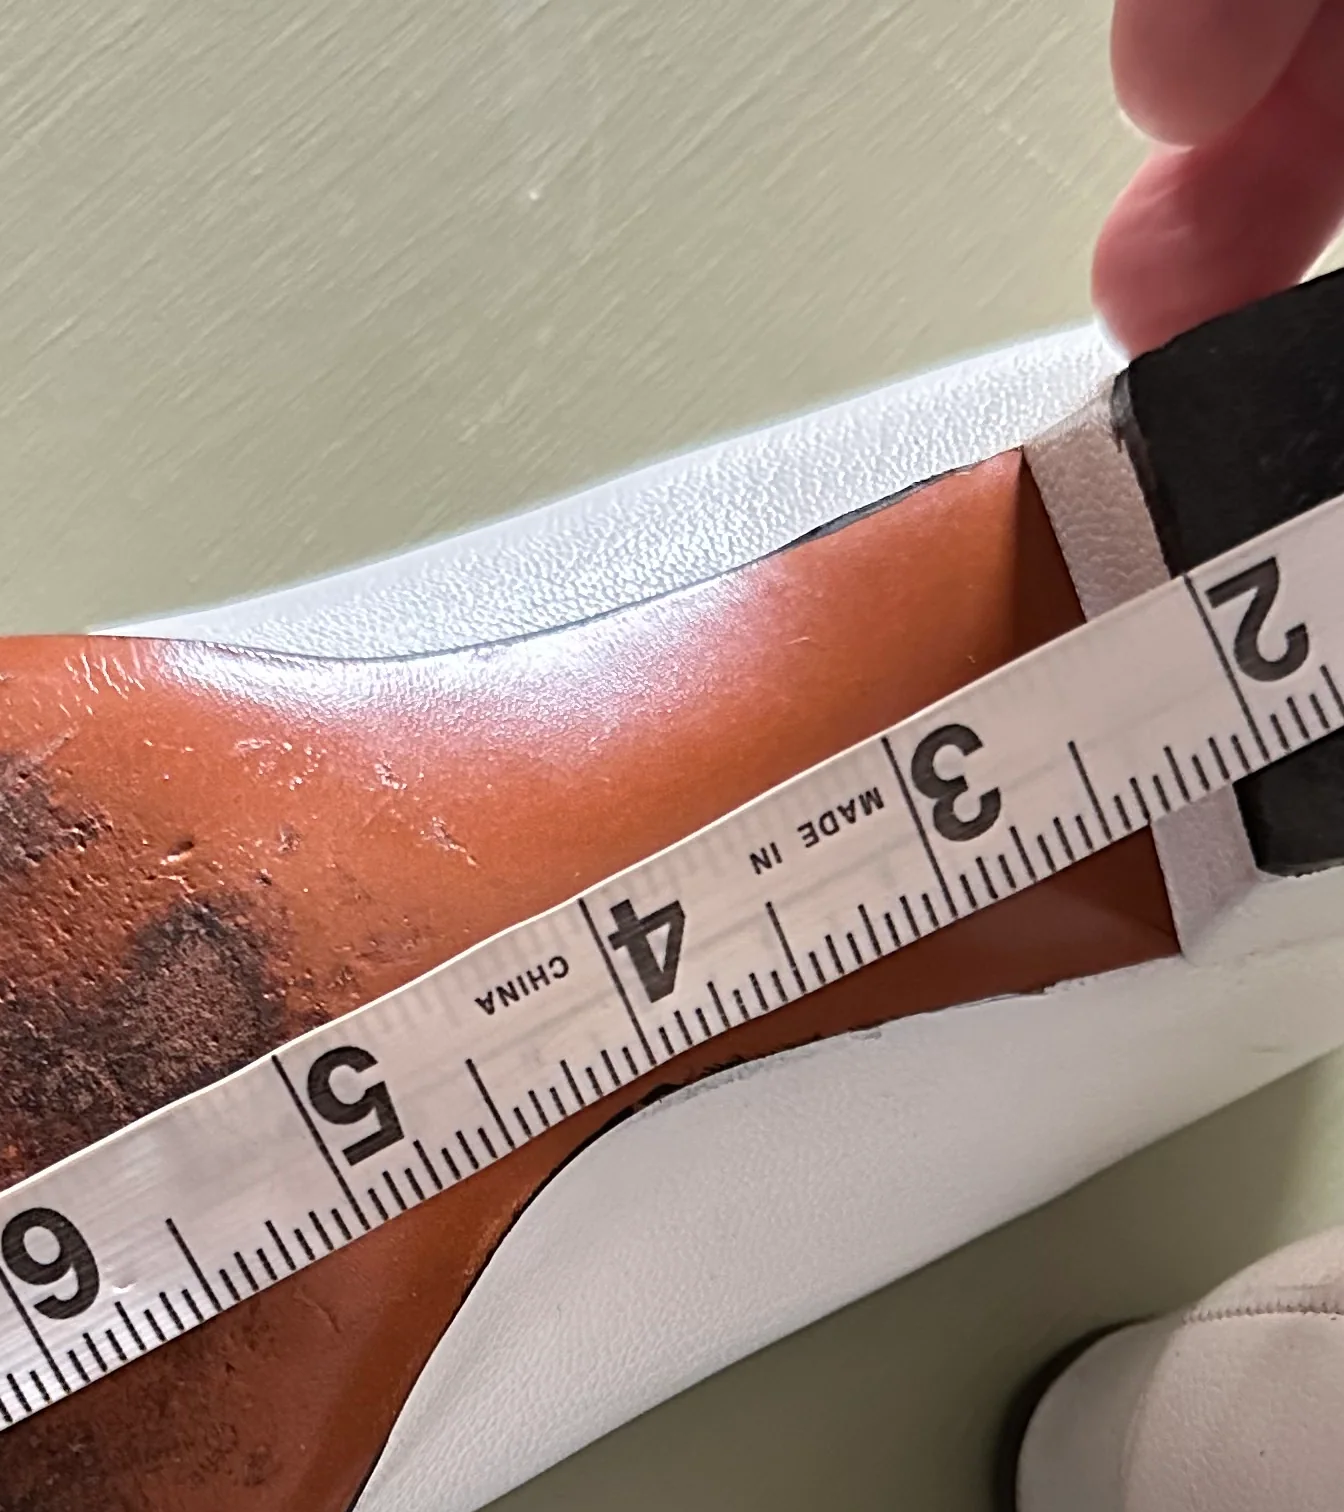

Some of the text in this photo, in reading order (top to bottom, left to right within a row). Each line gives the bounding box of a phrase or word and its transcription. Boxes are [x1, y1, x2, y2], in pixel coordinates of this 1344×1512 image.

[1206, 556, 1311, 683] 2
[910, 723, 1002, 842] 3
[474, 786, 886, 1016] MADE IN CHINA
[607, 898, 686, 1004] 4
[307, 1046, 405, 1166] 5
[0, 1207, 100, 1320] 6
